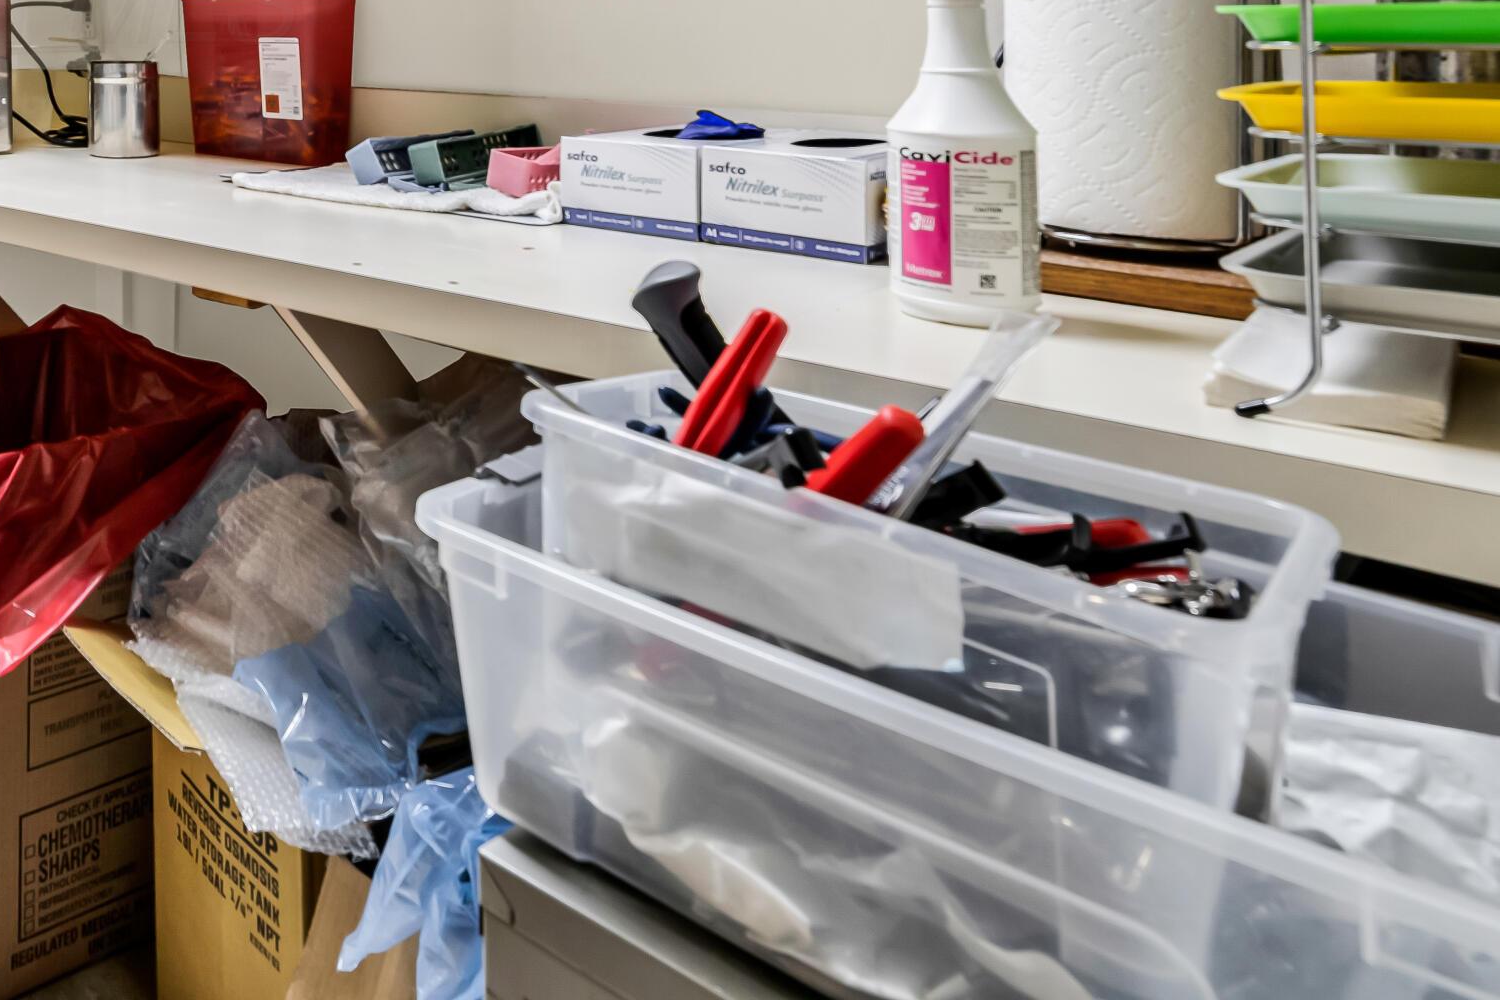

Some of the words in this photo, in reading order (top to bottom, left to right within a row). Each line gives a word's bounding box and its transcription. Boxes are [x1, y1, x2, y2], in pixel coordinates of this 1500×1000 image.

[567, 151, 598, 163] safco
[580, 164, 625, 182] Nitrilex
[708, 162, 747, 175] safco
[724, 177, 780, 197] Nitrilex
[38, 792, 152, 858] CHEMOTHERAP
[56, 801, 91, 823] CHECK
[168, 788, 198, 838] WATER
[199, 829, 246, 895] STORAGE
[248, 880, 280, 927] TANK
[181, 782, 221, 842] REVERSE
[224, 830, 280, 899] OSMOSIS
[38, 839, 101, 884] SHARPS
[11, 928, 78, 971] REGULATED
[256, 917, 280, 953] NPT
